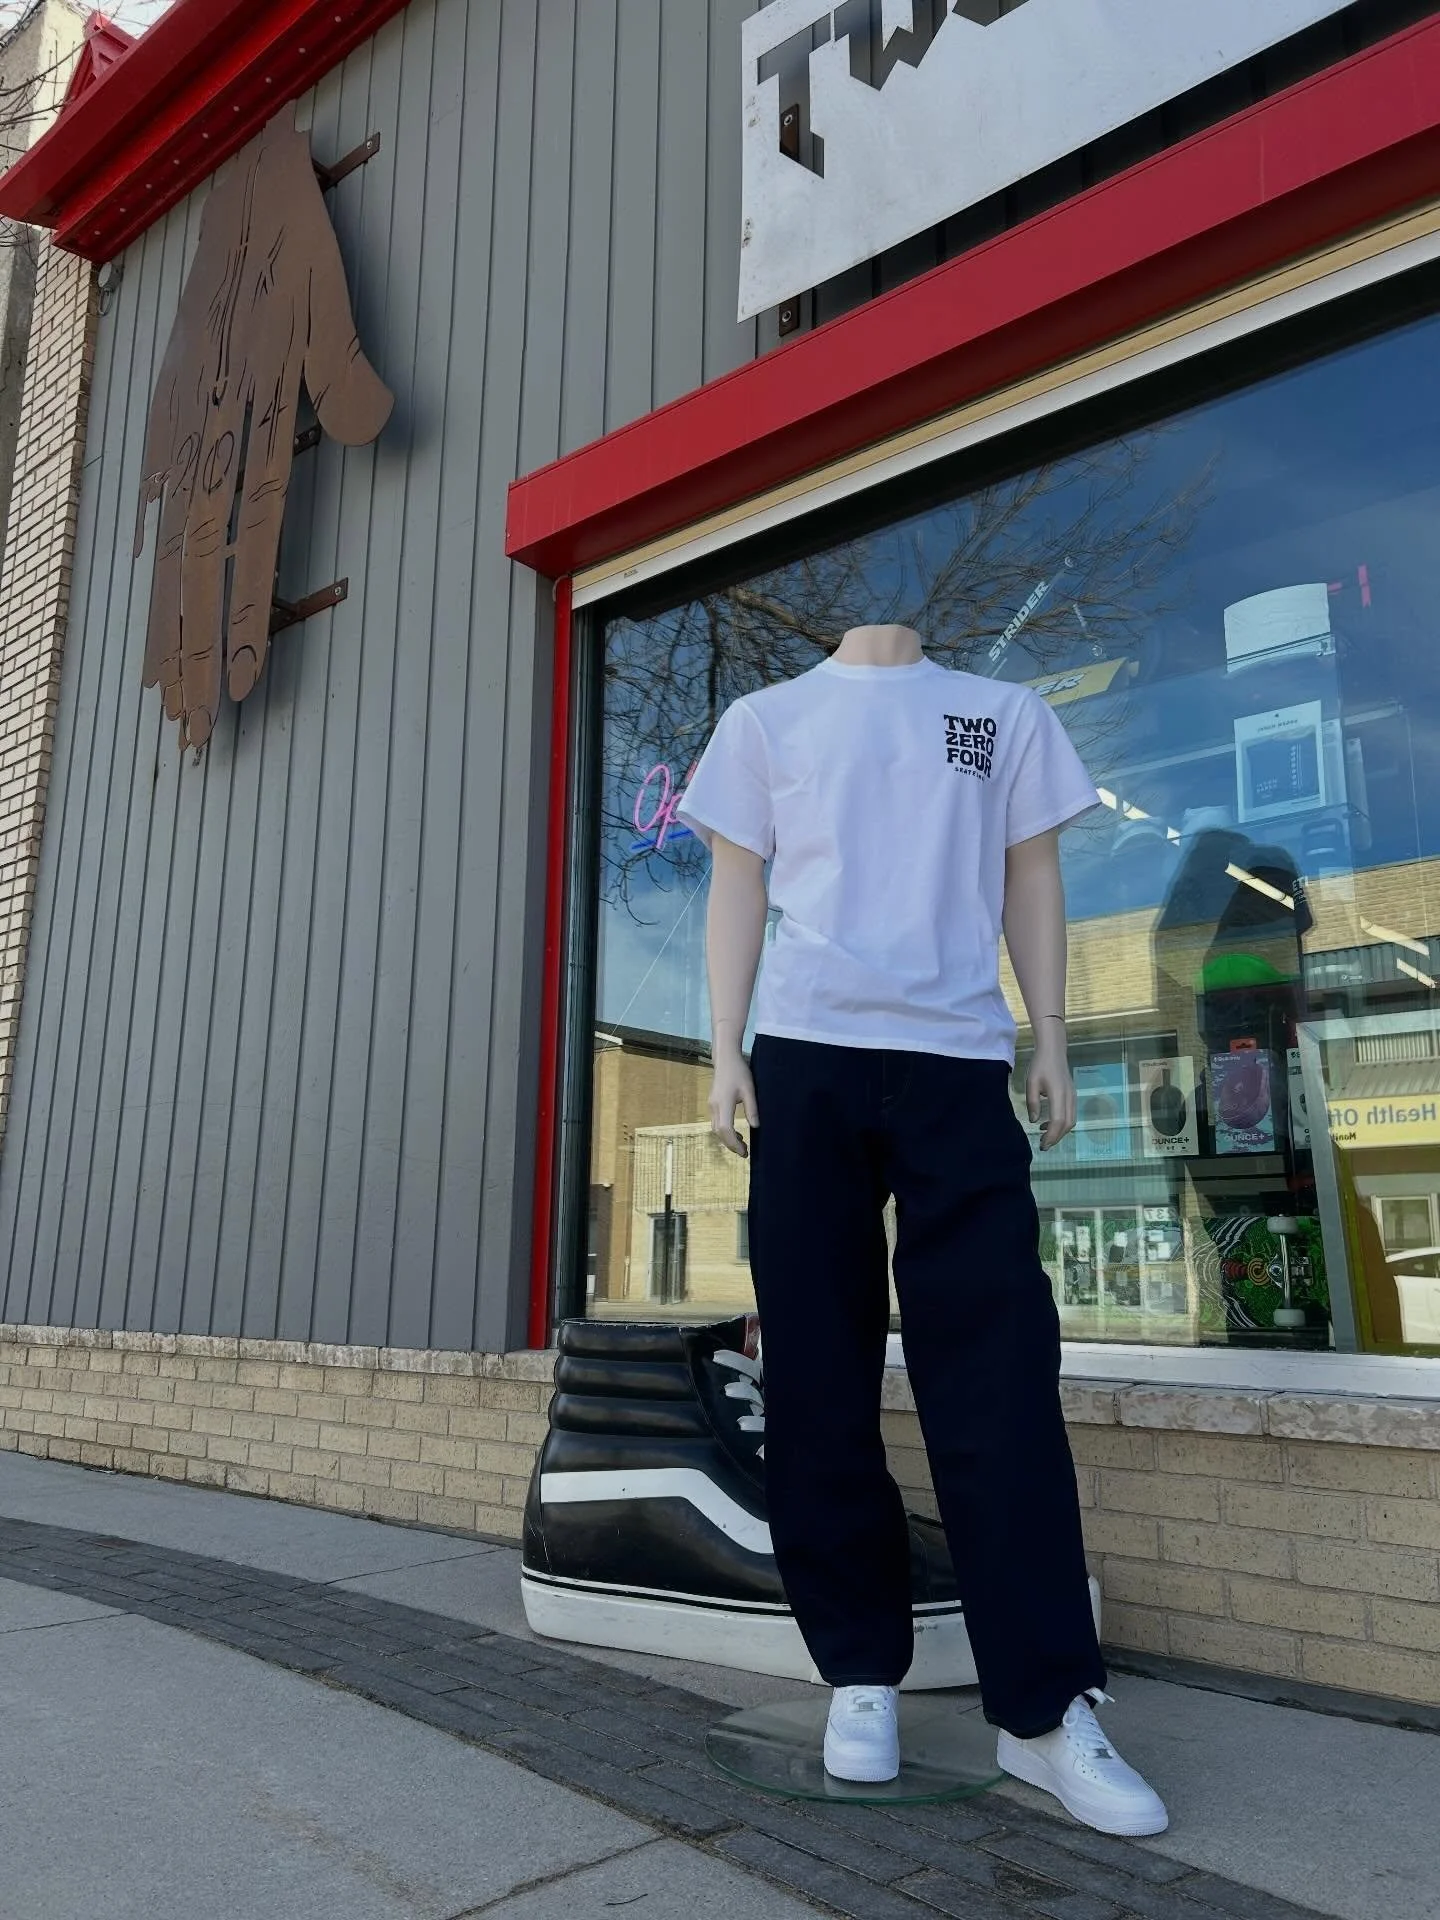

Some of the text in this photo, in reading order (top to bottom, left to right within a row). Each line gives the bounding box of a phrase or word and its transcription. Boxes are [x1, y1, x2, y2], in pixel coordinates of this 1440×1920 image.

[757, 0, 1031, 178] TW
[989, 581, 1050, 662] STRIDER
[944, 714, 996, 737] TWO
[945, 730, 994, 757] ZERO
[947, 747, 992, 778] FOUR
[634, 764, 684, 850] Op
